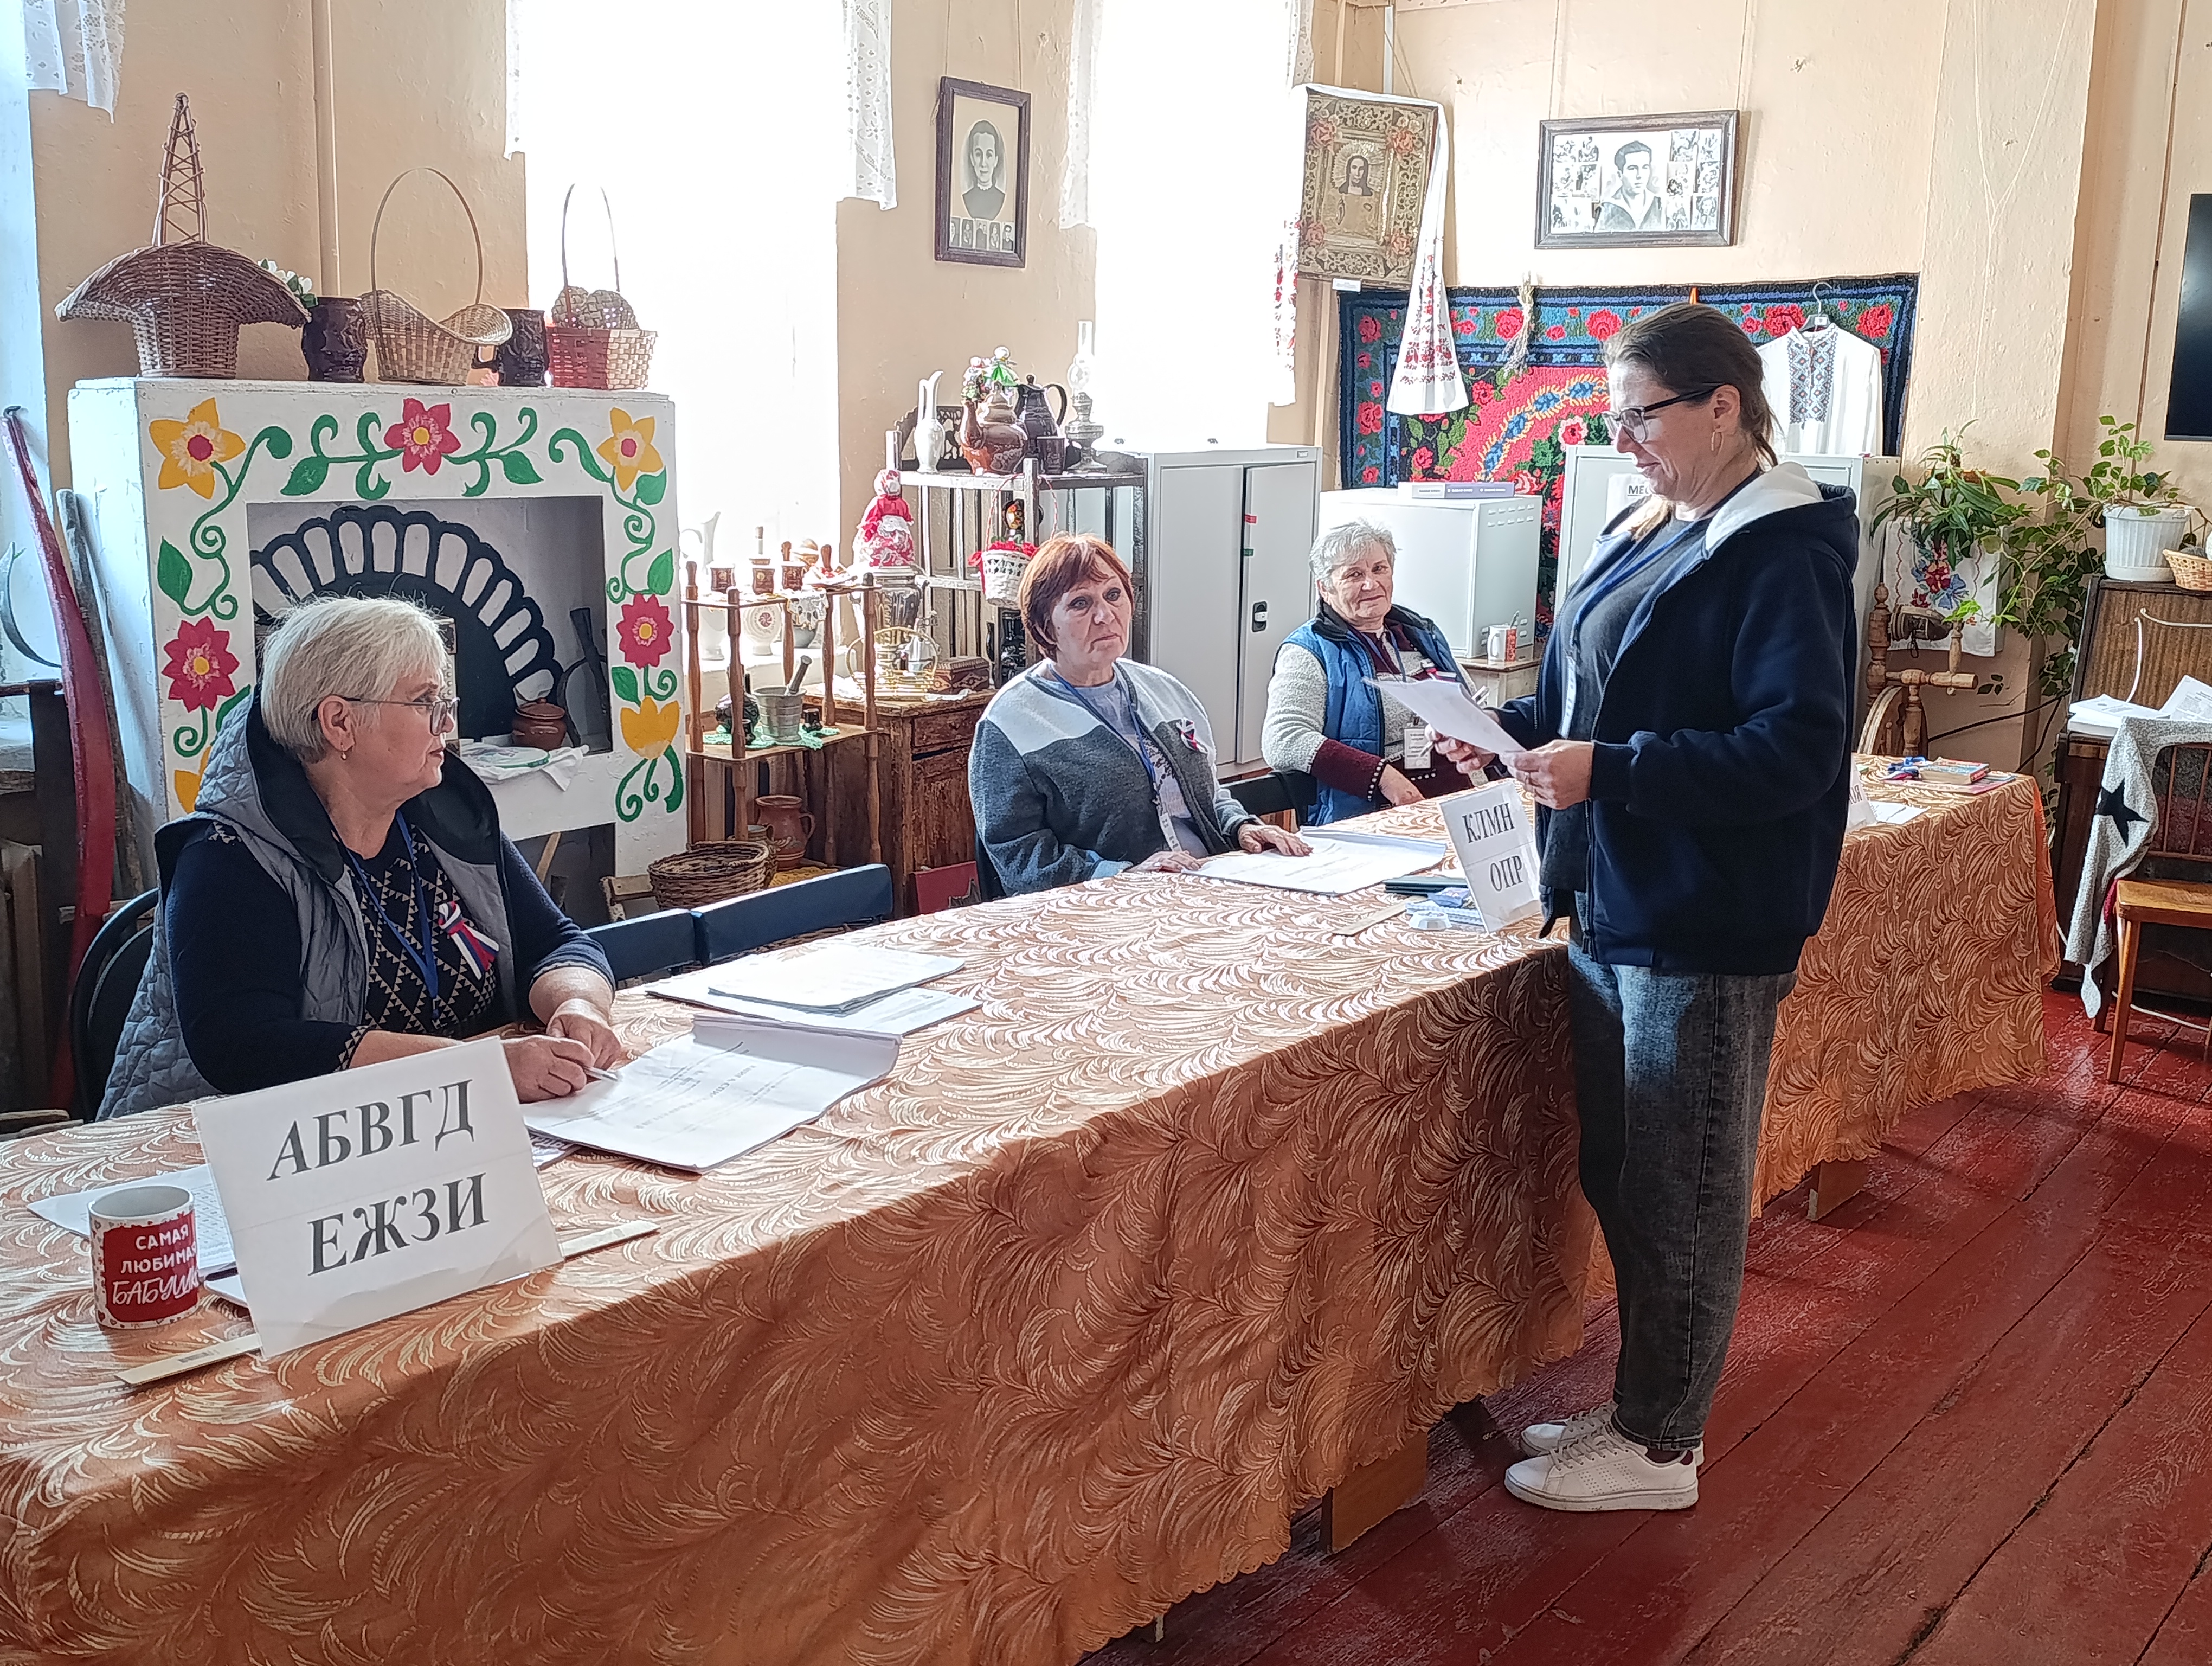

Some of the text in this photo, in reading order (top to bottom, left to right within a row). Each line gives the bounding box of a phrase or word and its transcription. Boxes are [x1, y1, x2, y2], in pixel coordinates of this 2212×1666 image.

[1462, 802, 1516, 843] КЛМН
[1490, 855, 1524, 892] ОПР
[266, 1079, 474, 1181] АБВГД
[136, 1223, 189, 1250] САМАЯ
[307, 1172, 490, 1277] ЕЖЗИ
[120, 1240, 196, 1274] ЛЮБИМАЯ
